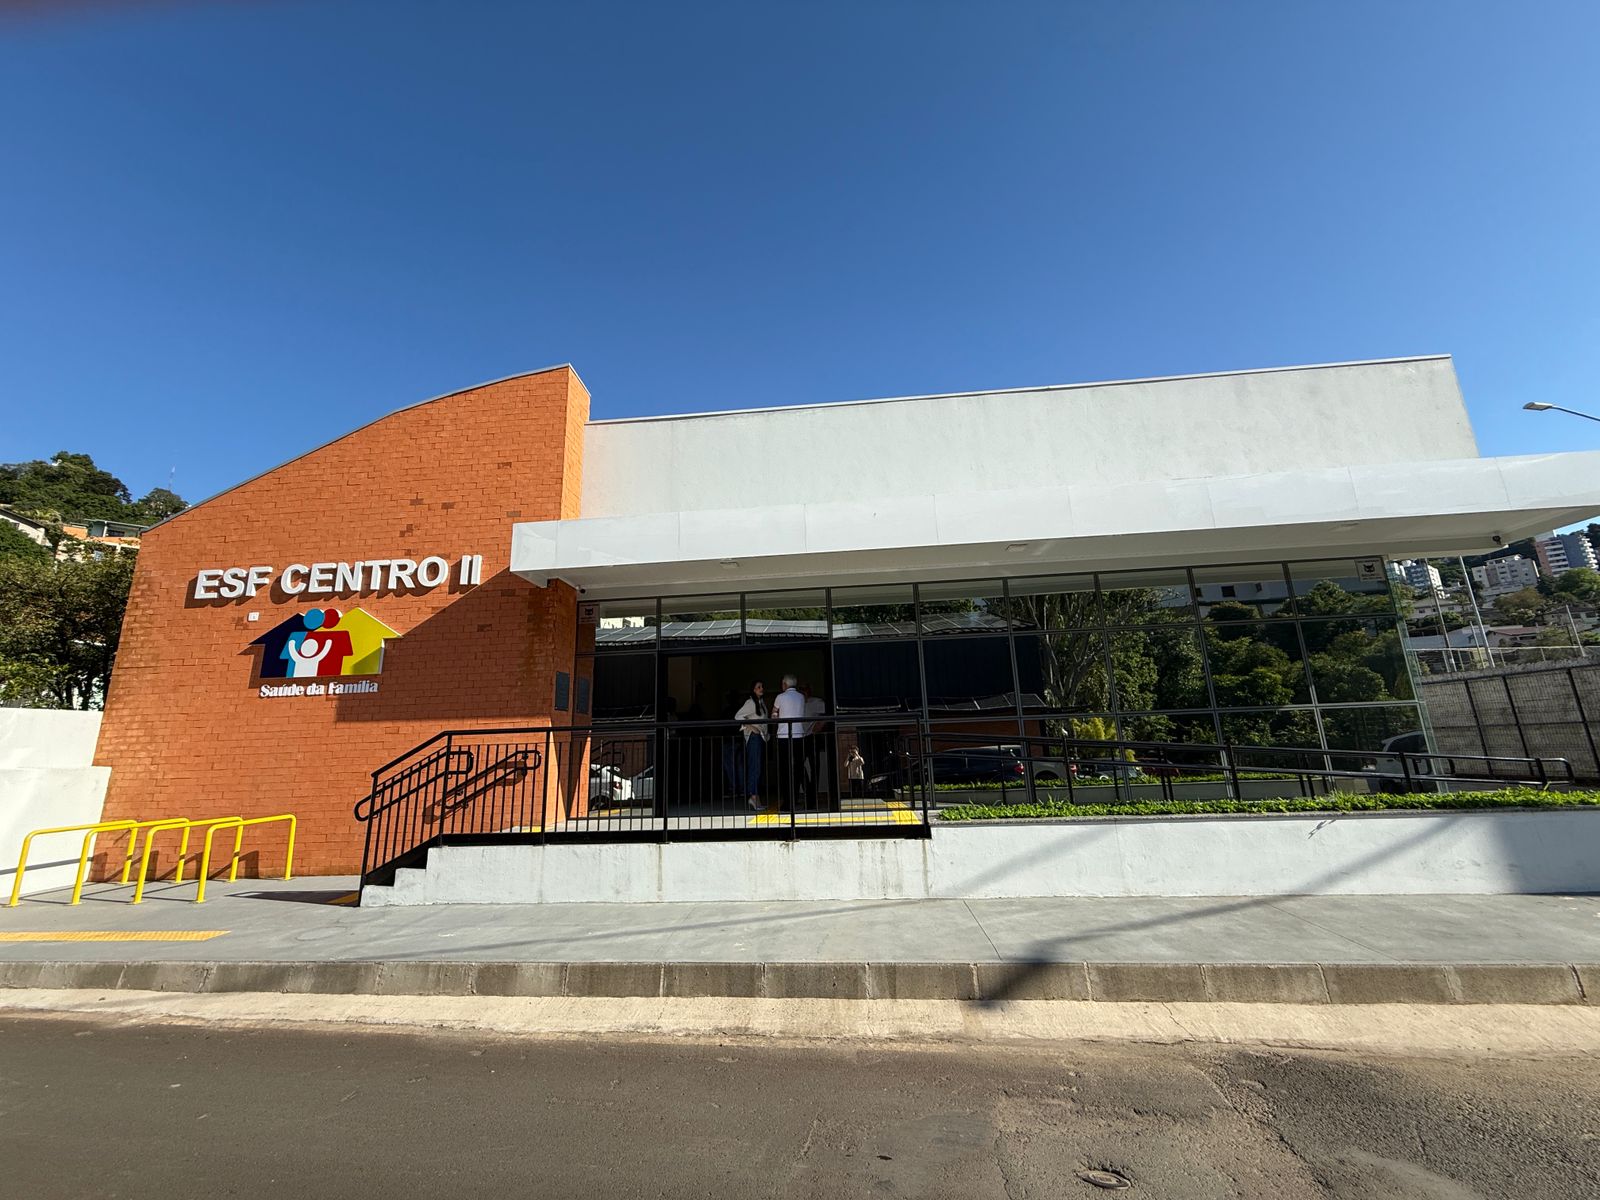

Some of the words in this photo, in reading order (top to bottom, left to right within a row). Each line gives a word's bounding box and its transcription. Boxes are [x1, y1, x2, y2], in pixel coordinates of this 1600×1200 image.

[194, 566, 273, 600] ESF
[280, 556, 449, 595] CENTRO
[459, 554, 483, 585] II
[260, 683, 305, 698] Saúde
[306, 682, 325, 696] da
[328, 680, 379, 695] Família
